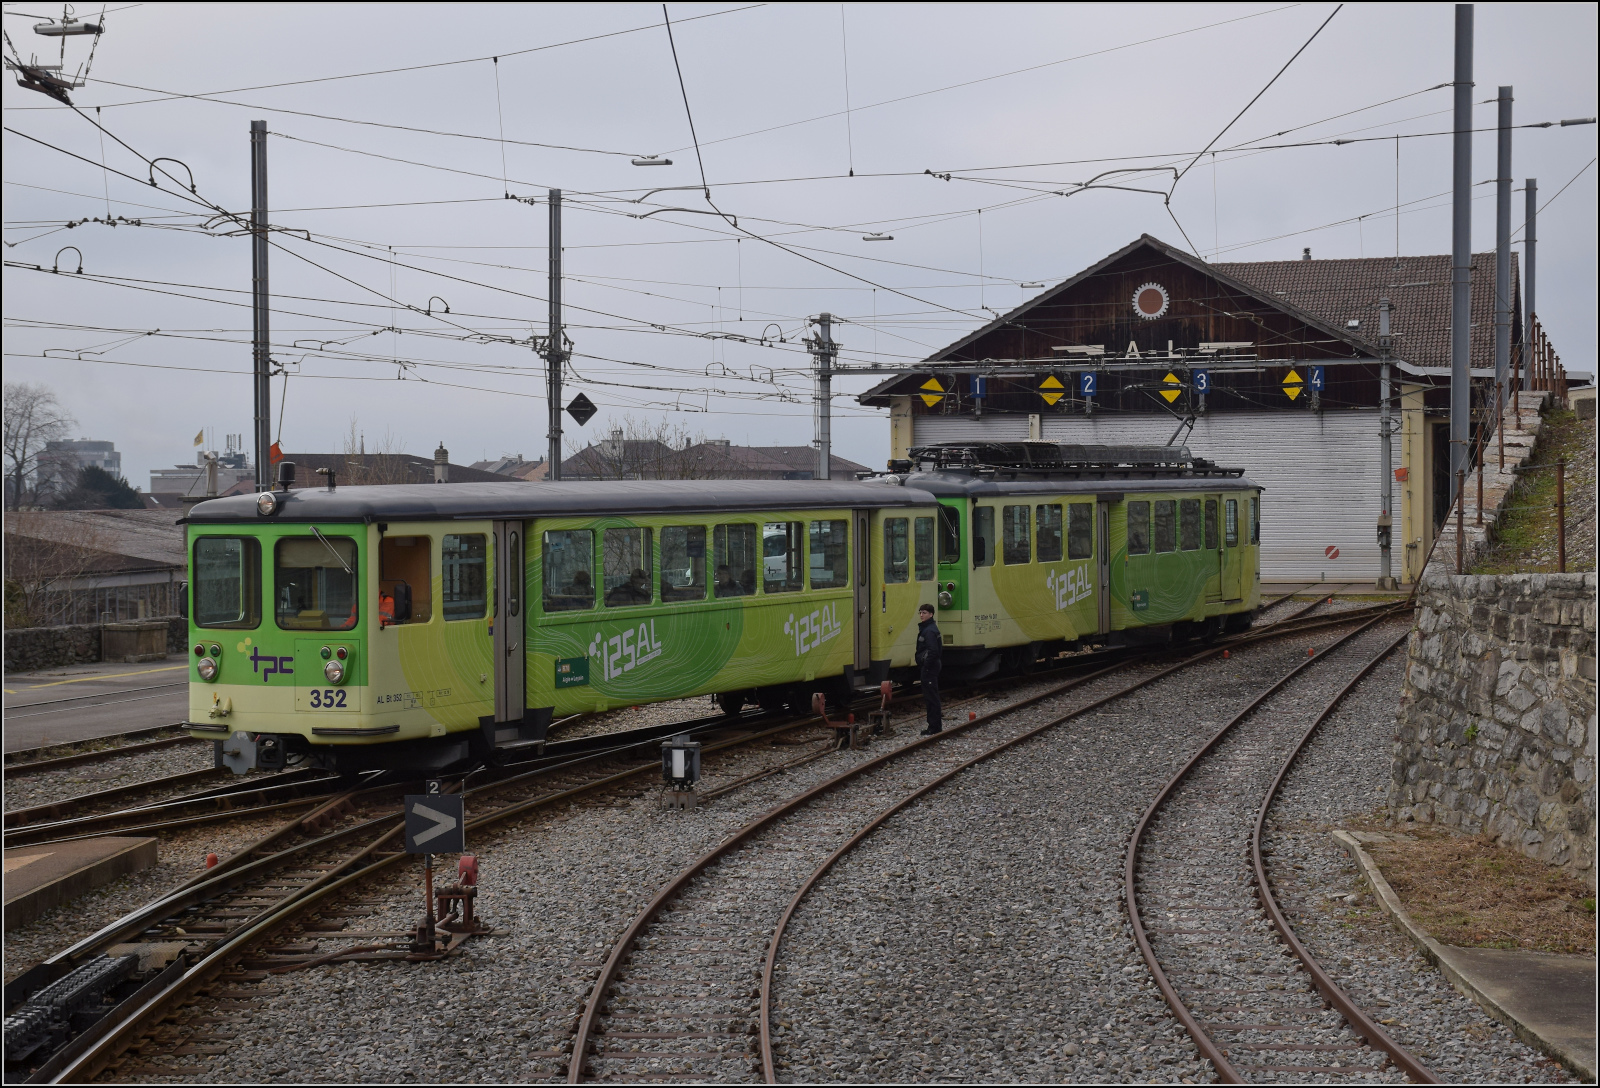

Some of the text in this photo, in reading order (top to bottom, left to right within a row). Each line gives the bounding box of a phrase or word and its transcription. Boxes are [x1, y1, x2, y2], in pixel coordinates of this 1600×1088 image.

[974, 377, 981, 395] 1
[1083, 375, 1094, 393] 2
[1196, 373, 1207, 390] 3
[1311, 369, 1321, 388] 4
[249, 646, 294, 683] tpc
[309, 689, 348, 709] 352
[376, 695, 385, 705] AL
[393, 693, 403, 703] 352
[429, 781, 439, 794] 2
